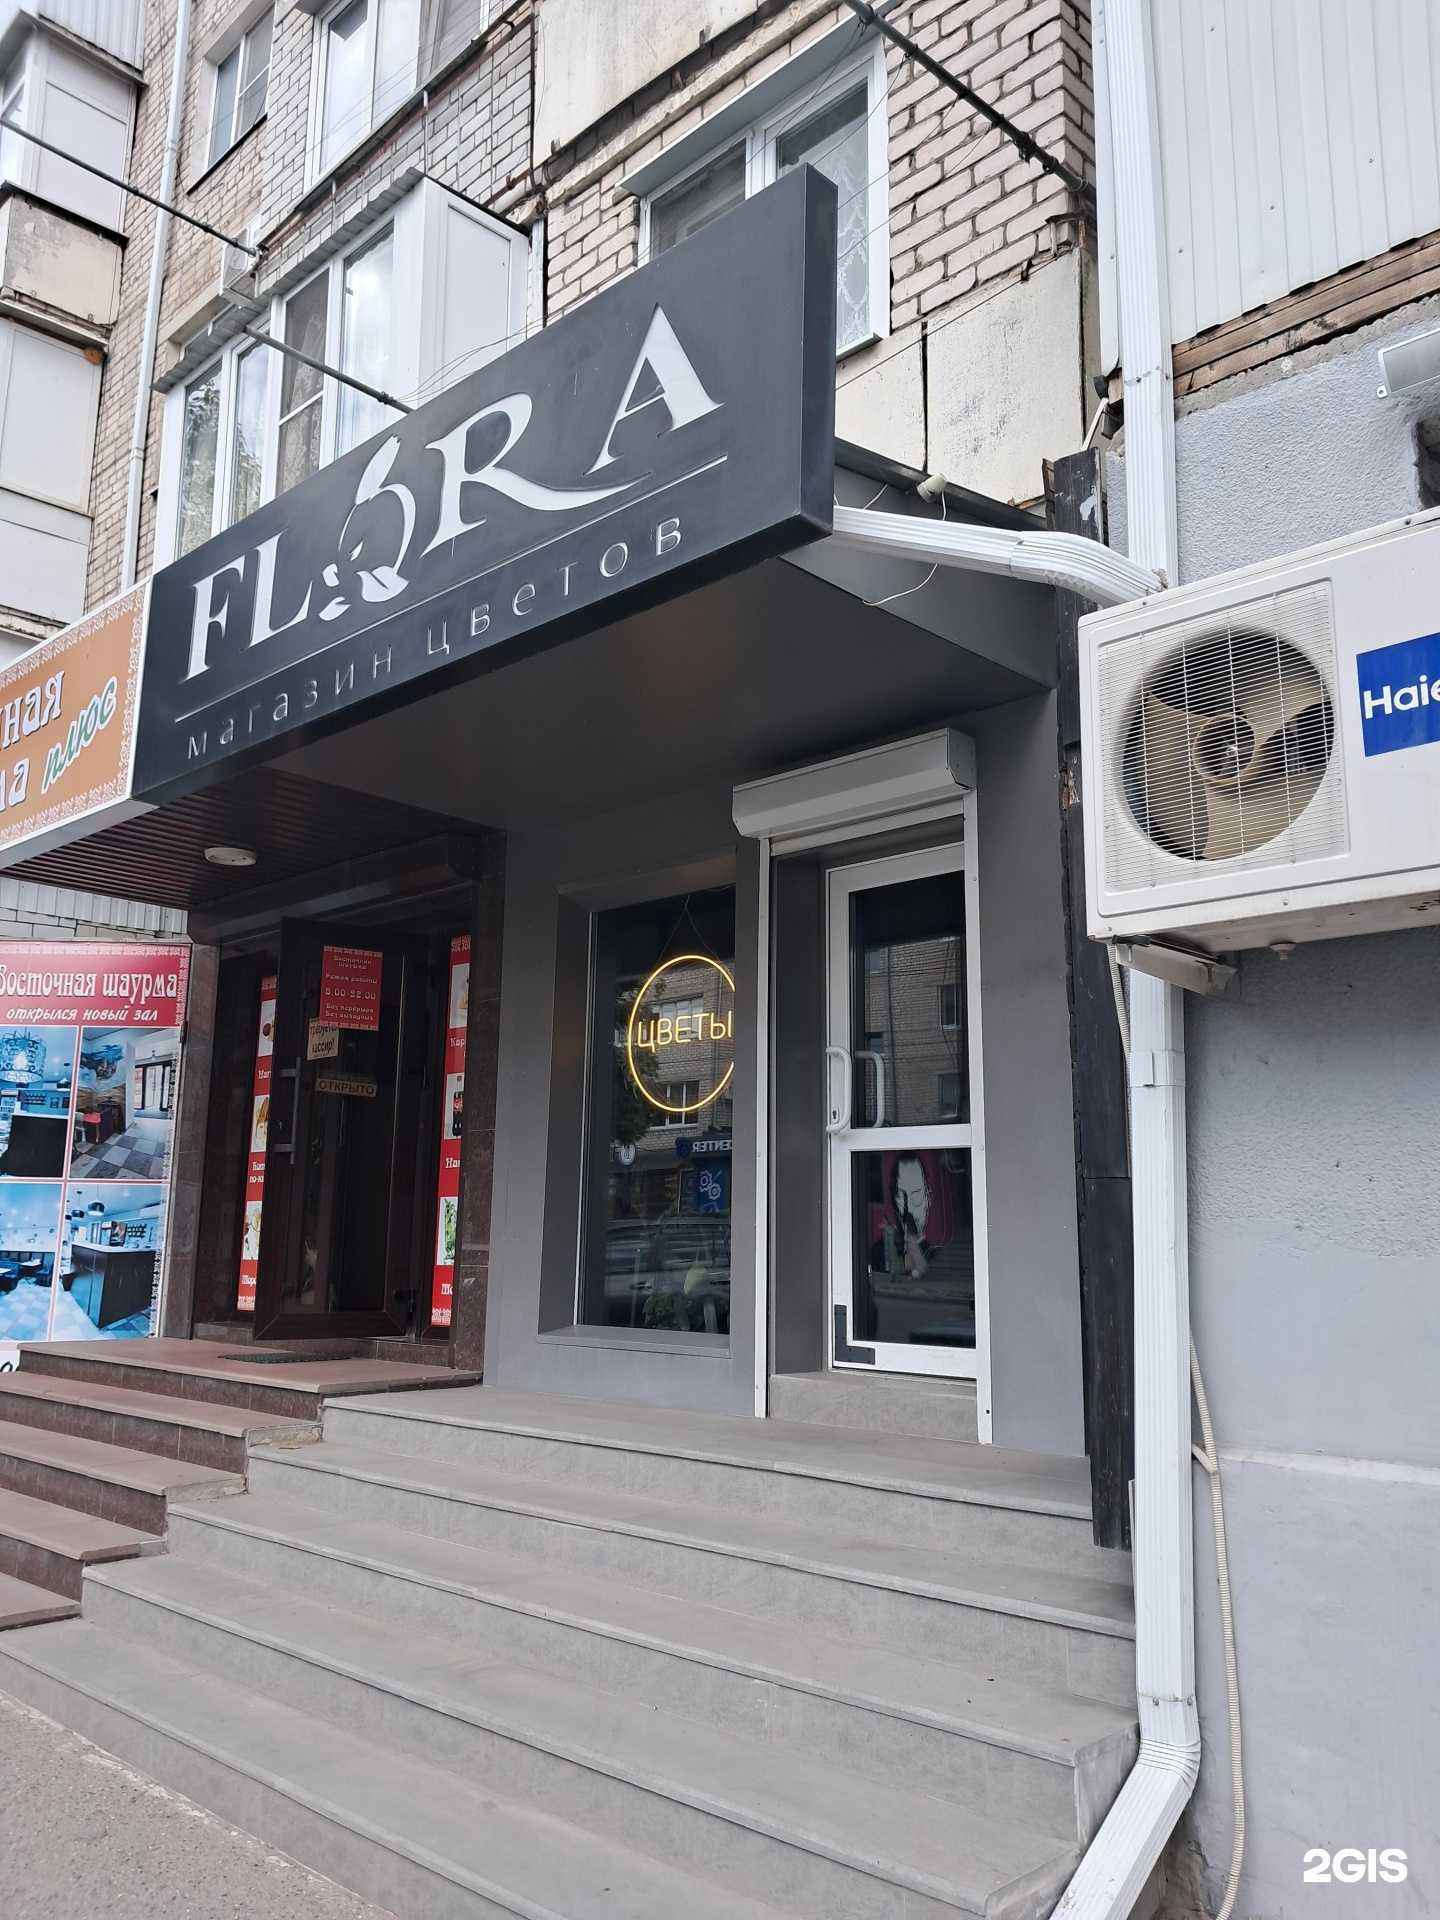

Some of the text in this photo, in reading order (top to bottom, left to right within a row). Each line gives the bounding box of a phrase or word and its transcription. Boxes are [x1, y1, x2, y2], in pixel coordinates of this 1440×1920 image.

[186, 517, 683, 760] магазин цветов
[102, 972, 178, 1005] шаурма
[7, 1003, 157, 1022] открылся новый зал
[637, 1010, 733, 1053] ЦВЕТЫ
